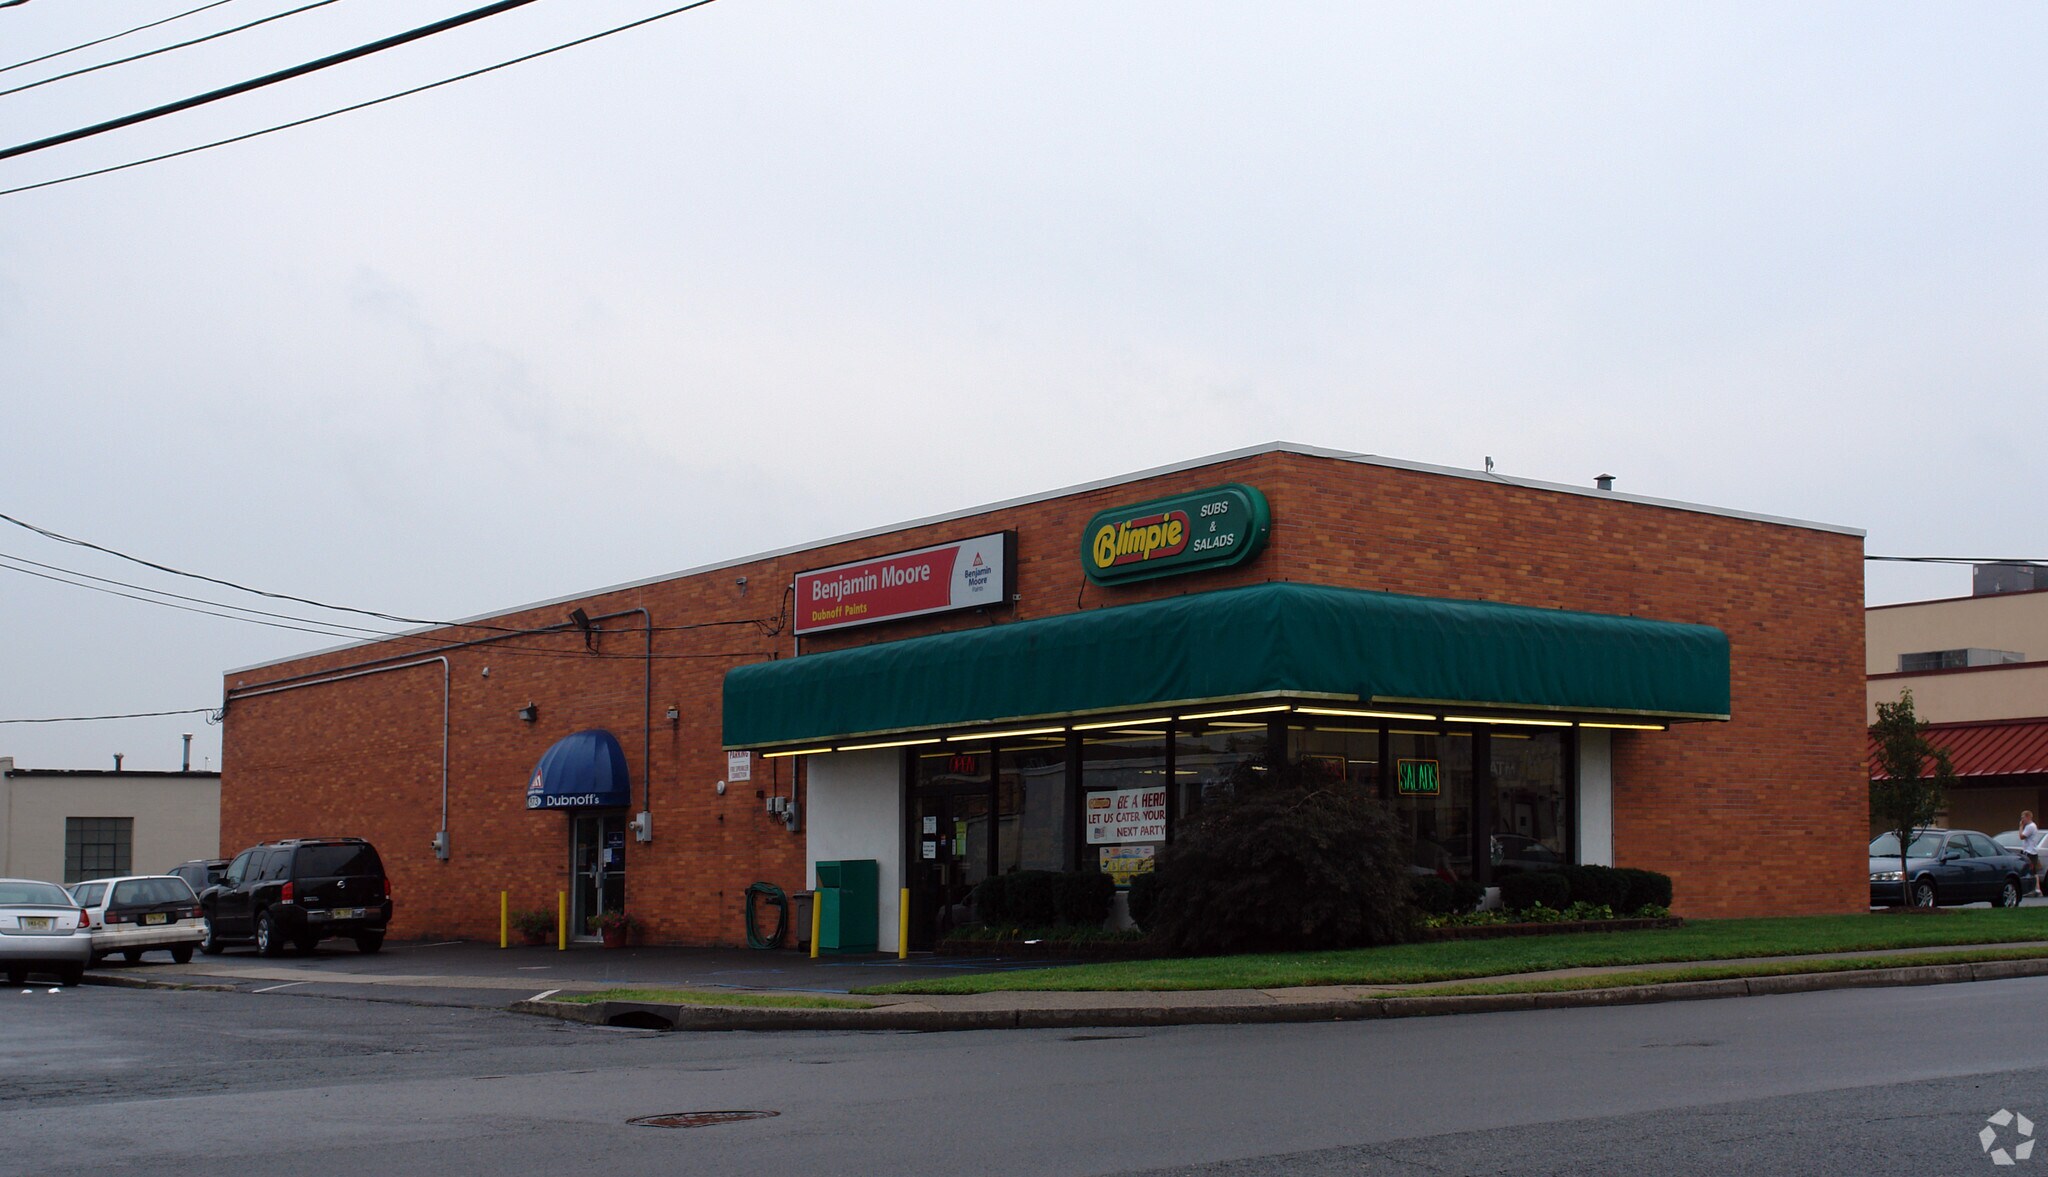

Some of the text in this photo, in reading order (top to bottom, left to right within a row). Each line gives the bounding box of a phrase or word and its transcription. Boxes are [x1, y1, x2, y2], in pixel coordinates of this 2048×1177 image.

[1200, 501, 1229, 517] SUBS
[1209, 521, 1217, 532] &
[1093, 513, 1182, 568] Blimpie
[1193, 534, 1234, 552] SALADS
[964, 566, 992, 579] Benjamin
[812, 564, 930, 602] Benjamin Moore
[968, 576, 988, 586] Moore
[811, 603, 868, 622] Dubnoff Paints
[949, 755, 975, 773] OPEN
[1400, 763, 1438, 791] SALADS
[546, 793, 600, 806] Dubnoff's
[1117, 795, 1128, 809] BE
[1132, 794, 1138, 808] A
[1142, 792, 1165, 808] HERO
[1088, 810, 1166, 824] LET US CATER YOUR
[1116, 825, 1166, 837] NEXT PARTY
